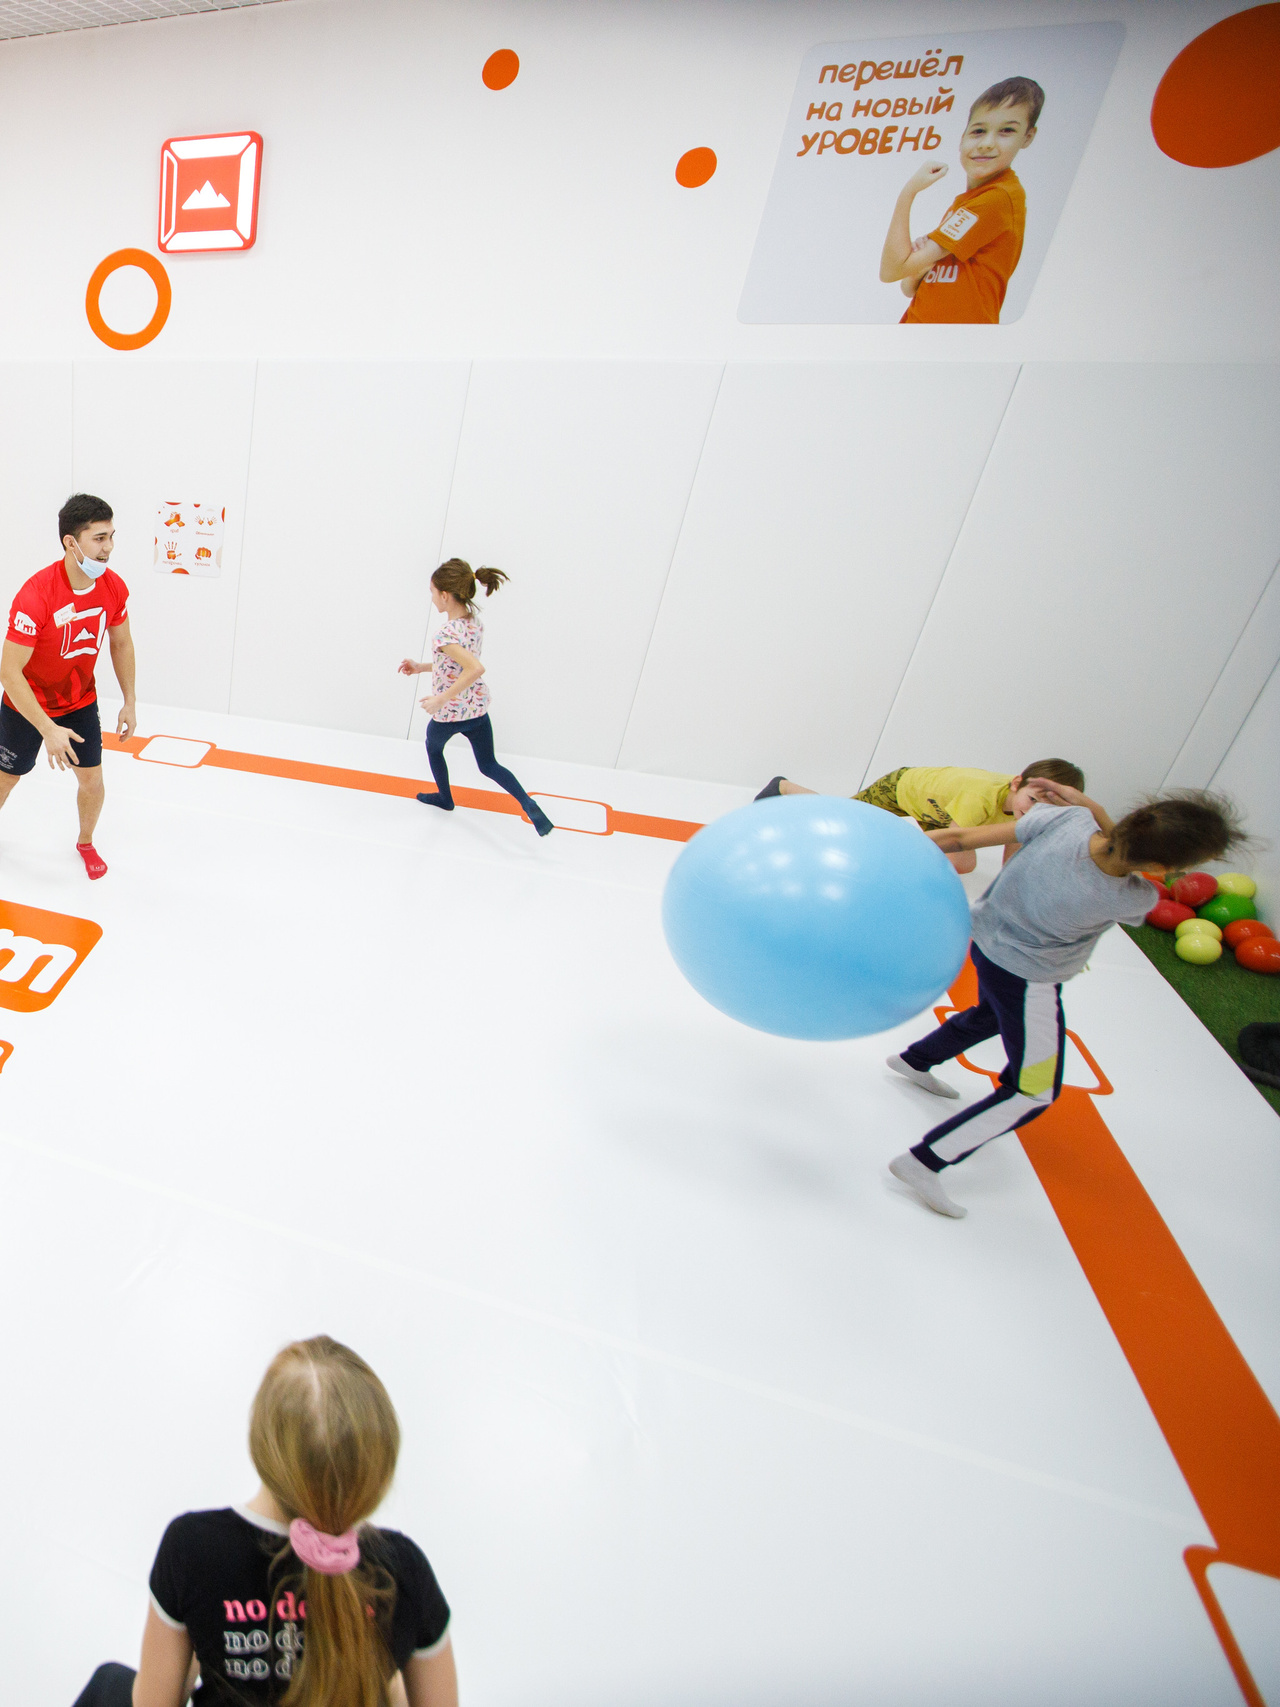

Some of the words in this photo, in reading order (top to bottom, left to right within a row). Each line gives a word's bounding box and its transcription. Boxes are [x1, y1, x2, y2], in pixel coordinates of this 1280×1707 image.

[818, 48, 964, 91] перешёл
[806, 101, 843, 121] на
[851, 86, 955, 118] новый
[796, 125, 942, 157] УРОВЕНЬ
[223, 1599, 268, 1623] no
[223, 1629, 270, 1655] no
[224, 1658, 270, 1681] no
